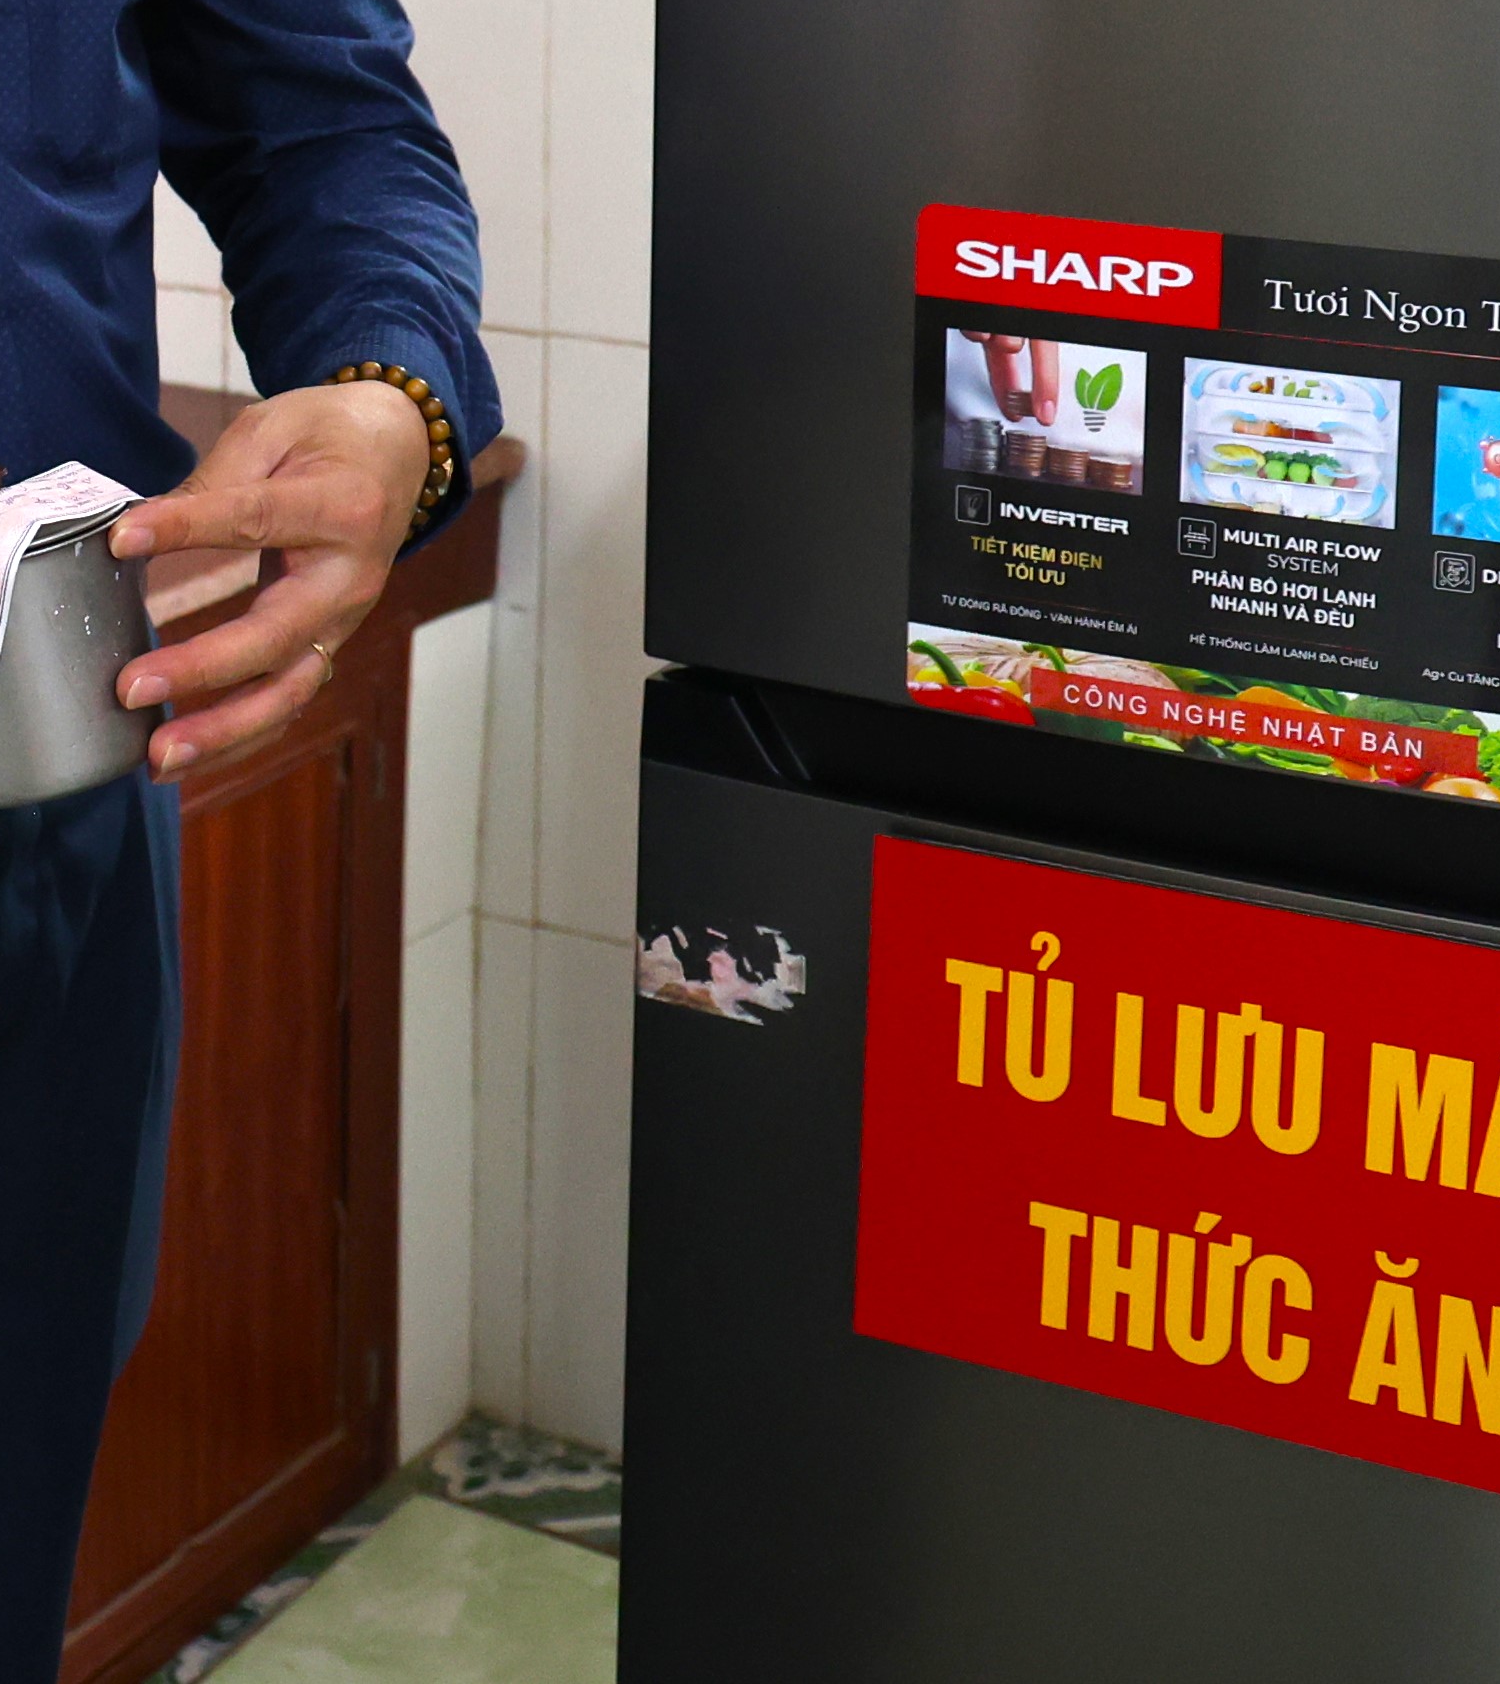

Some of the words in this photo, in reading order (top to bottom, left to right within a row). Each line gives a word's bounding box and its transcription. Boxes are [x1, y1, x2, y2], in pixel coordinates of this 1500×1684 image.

[954, 239, 1195, 298] SHARP
[1263, 278, 1350, 317] Tươi
[1363, 288, 1468, 334] Ngon
[999, 501, 1130, 536] INVERTER
[1011, 542, 1057, 564] KIỆM
[1060, 549, 1103, 572] ĐIỆN
[1222, 527, 1280, 549] MULTI
[1283, 535, 1319, 555] AIR
[1322, 541, 1382, 563] FLOW
[1038, 568, 1067, 586] ƯU
[1266, 553, 1340, 577] SYSTEM
[1191, 568, 1244, 592] PHÂN
[1282, 581, 1319, 601] HƠI
[1322, 586, 1377, 610] LẠNH
[1210, 593, 1278, 618] NHANH
[1282, 602, 1310, 622] VÀ
[1313, 608, 1356, 629] ĐỀU
[1208, 635, 1252, 653] THỐNG
[1254, 642, 1281, 658] LÀM
[1318, 652, 1339, 665] ĐA
[1421, 667, 1446, 683] Ag+
[1446, 671, 1465, 683] Cu
[1062, 683, 1149, 717] CÔNG
[1162, 700, 1248, 734] NGHỆ
[1262, 714, 1347, 750] NHẬT
[1359, 725, 1424, 761] BẢN
[944, 930, 1074, 1104] TỦ
[1110, 990, 1326, 1156] LƯU
[1028, 1199, 1314, 1386] THỨC
